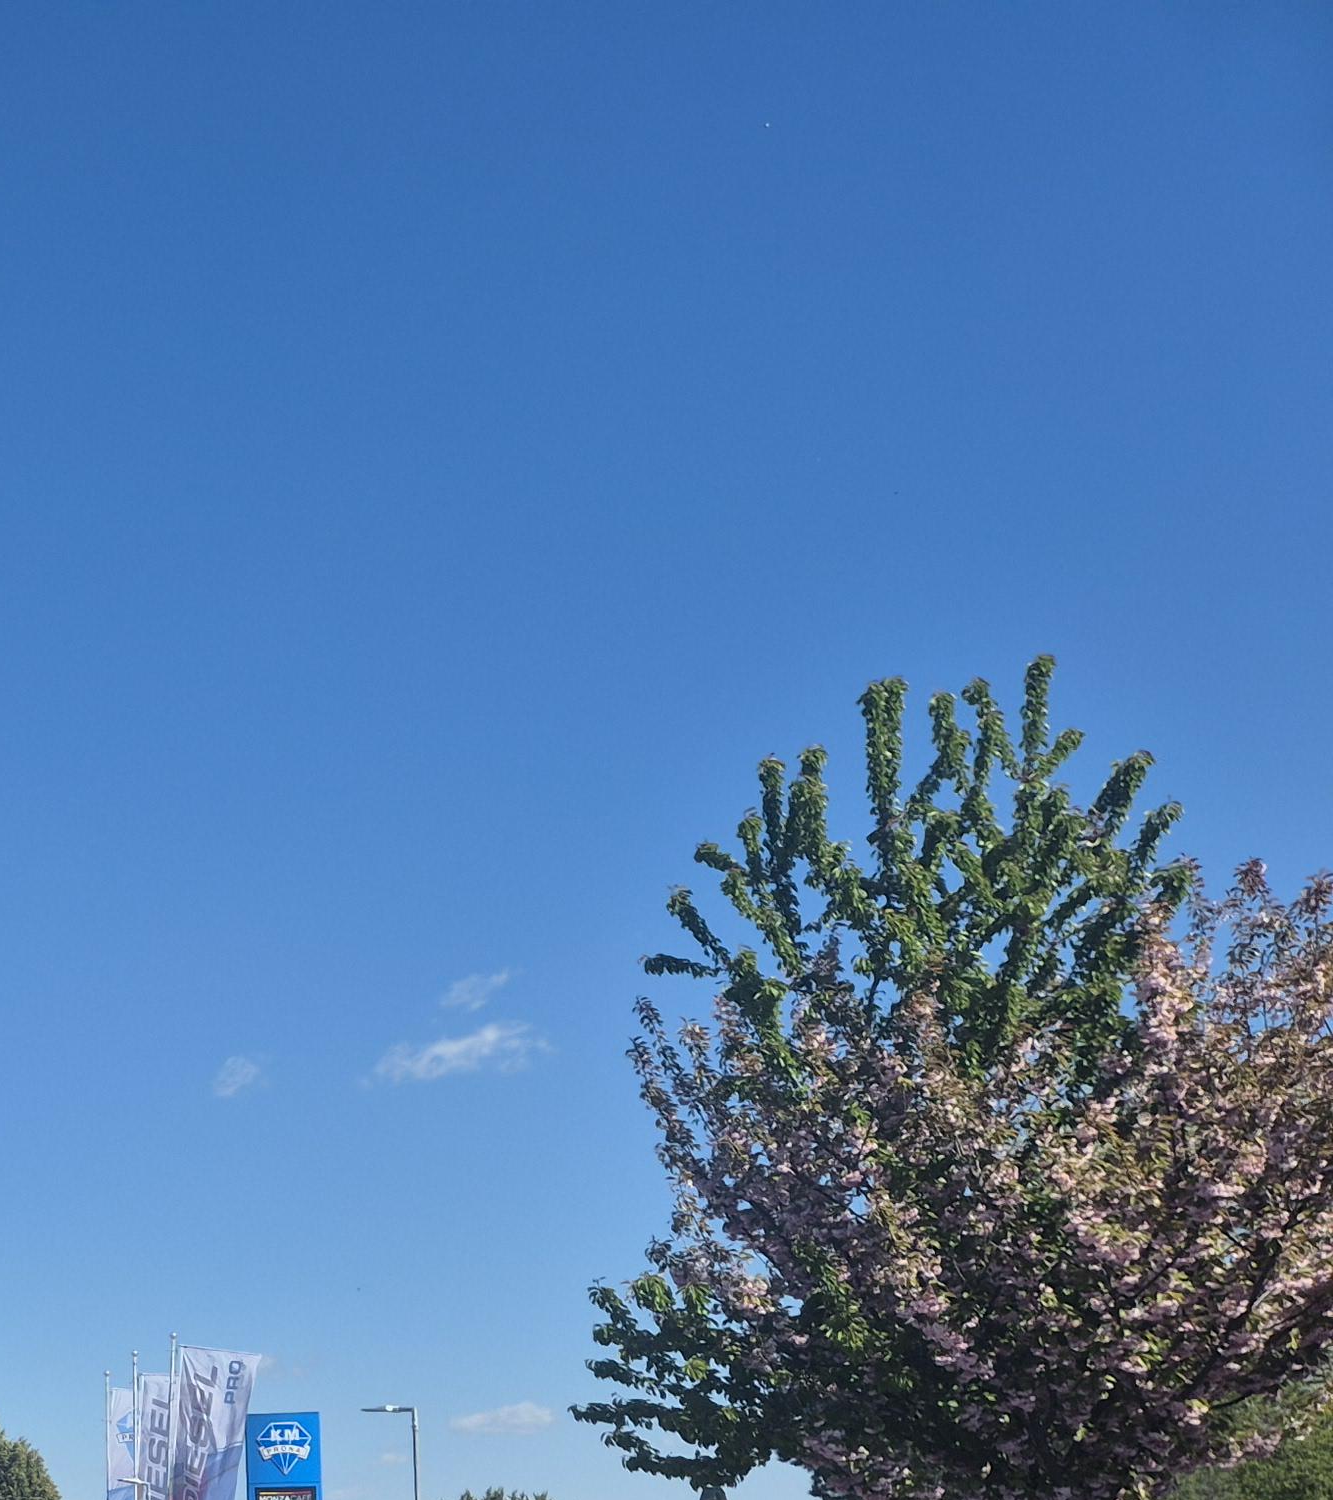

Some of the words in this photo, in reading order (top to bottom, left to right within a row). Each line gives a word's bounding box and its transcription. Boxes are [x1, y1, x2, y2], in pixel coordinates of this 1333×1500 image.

[224, 1360, 244, 1405] PRO
[270, 1429, 300, 1441] KM
[266, 1446, 301, 1454] PRONA
